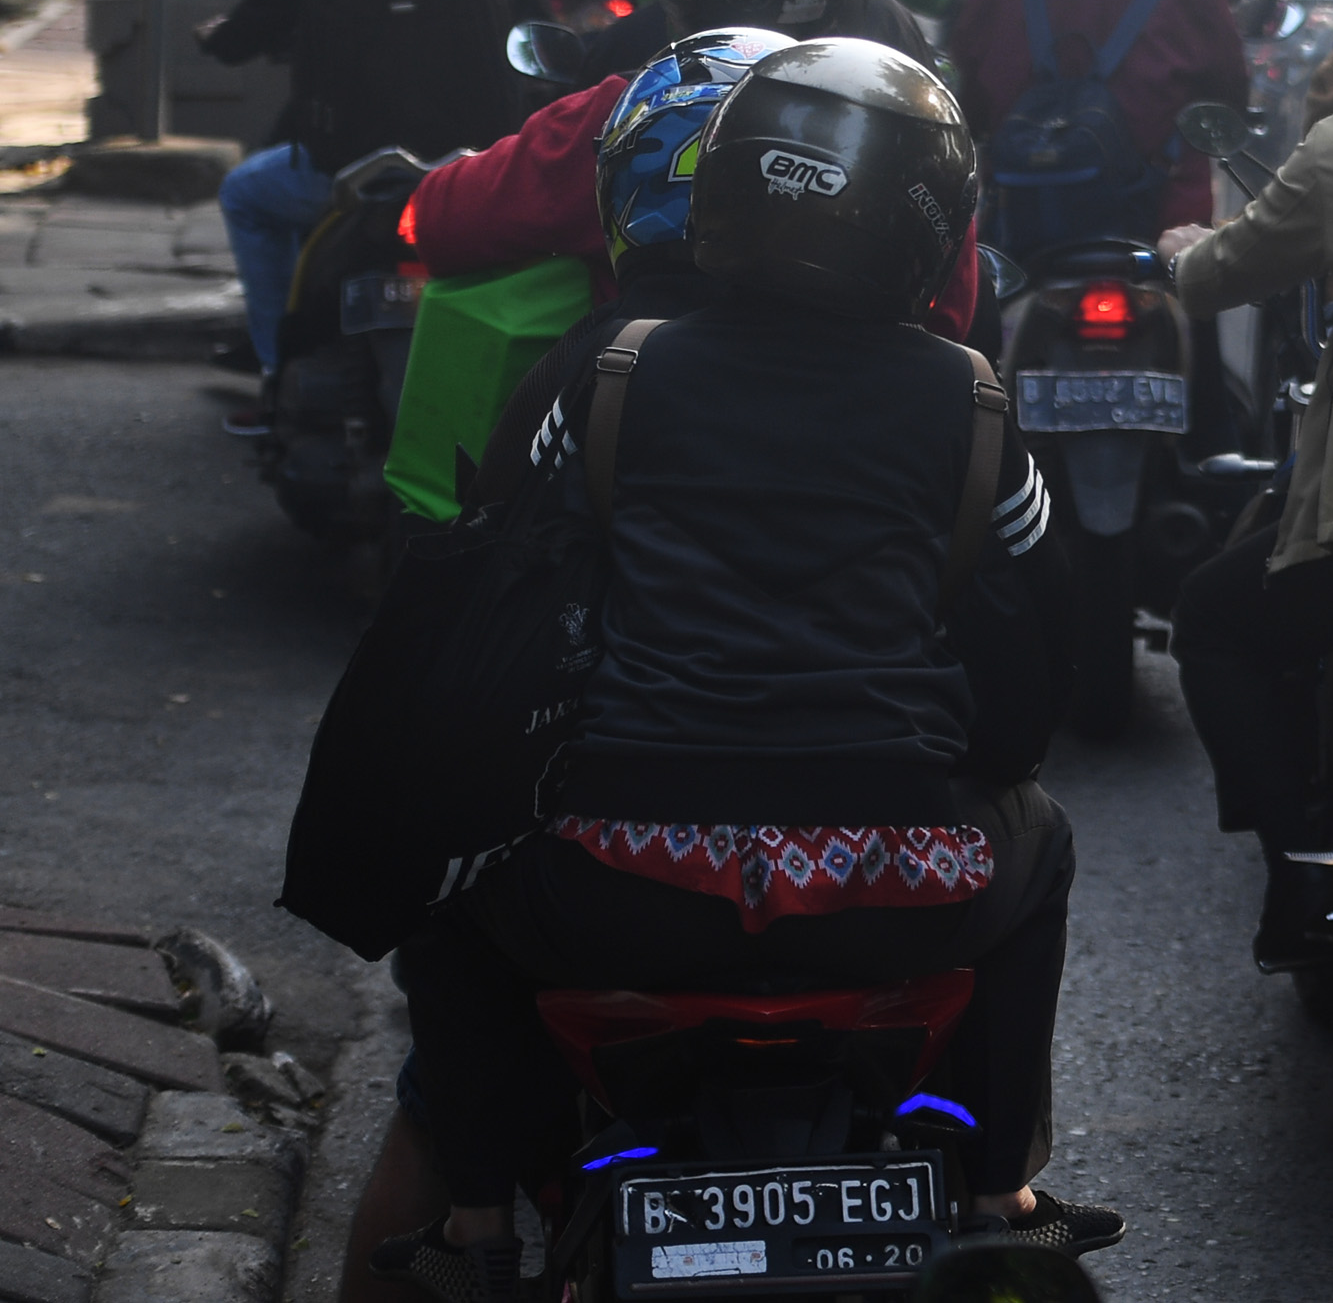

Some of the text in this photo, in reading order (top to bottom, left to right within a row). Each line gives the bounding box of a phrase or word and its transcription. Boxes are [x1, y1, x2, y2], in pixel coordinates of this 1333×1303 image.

[766, 155, 841, 191] BMC
[643, 1177, 921, 1235] B 3905 EGJ
